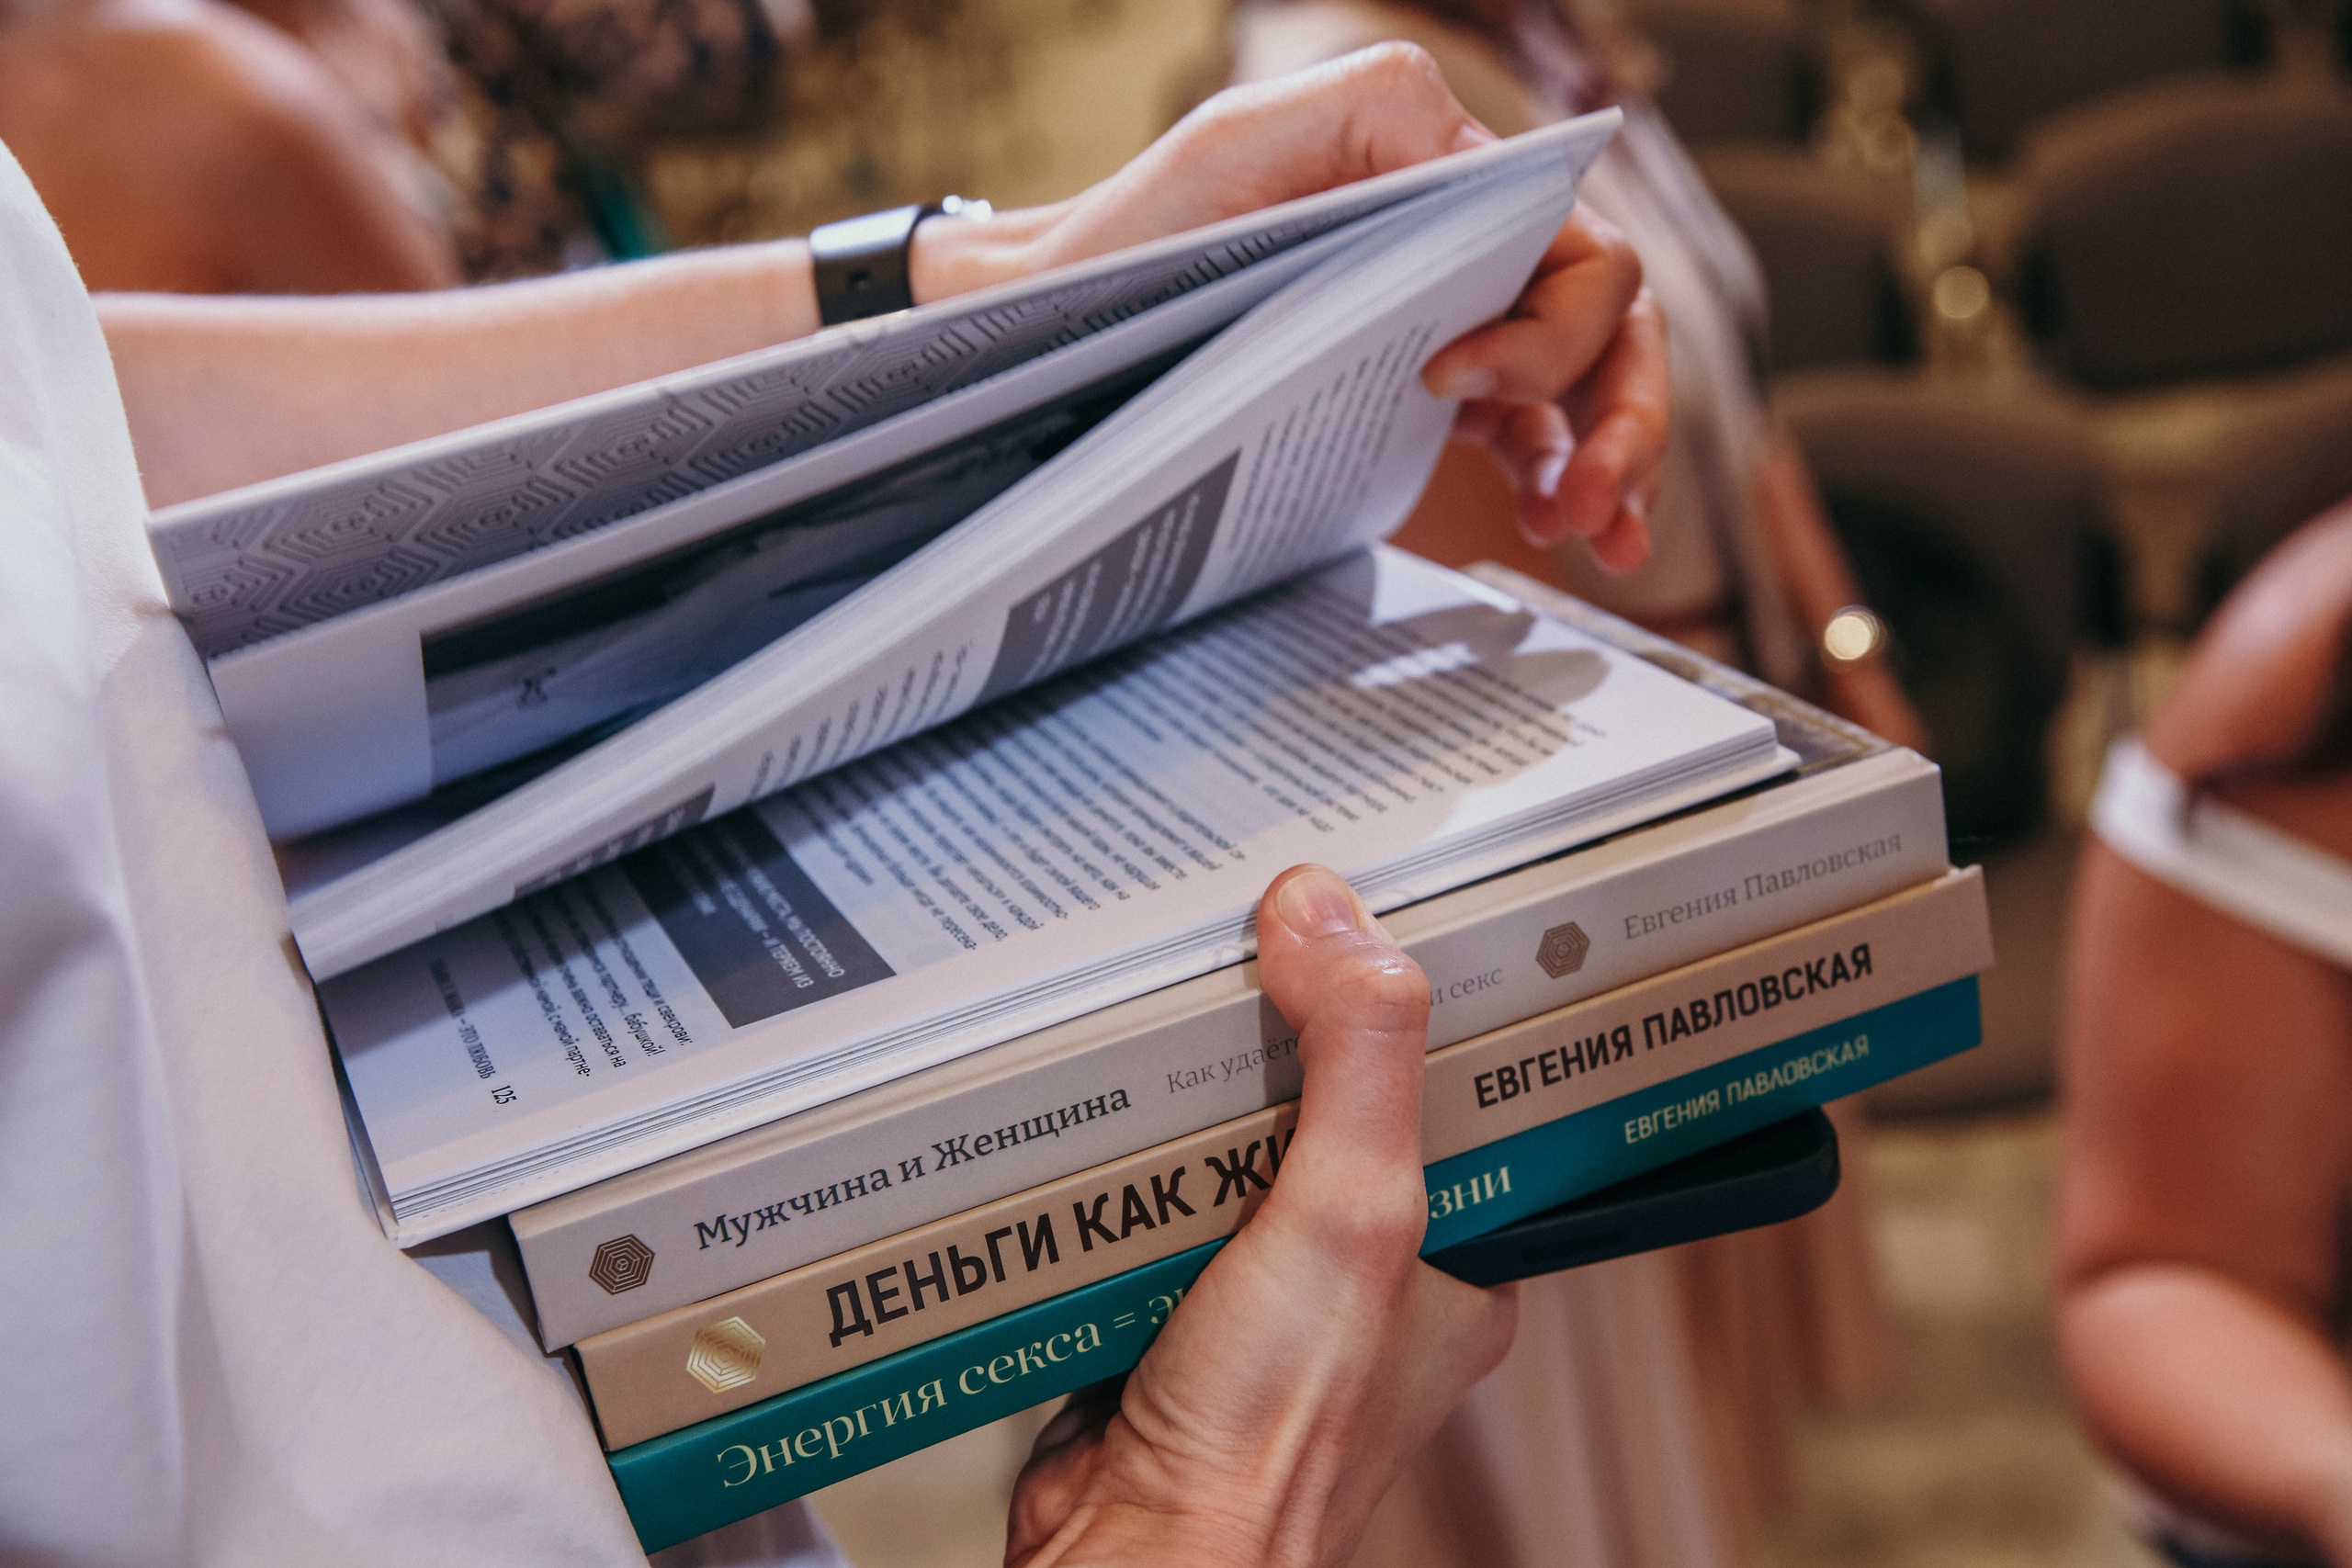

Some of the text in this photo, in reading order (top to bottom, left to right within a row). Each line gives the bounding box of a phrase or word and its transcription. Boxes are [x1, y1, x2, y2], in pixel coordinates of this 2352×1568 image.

[1623, 832, 1904, 942] Евгения Павловская
[467, 1042, 497, 1080] ЛЮБОВЬ
[564, 1042, 592, 1077] партне-
[584, 1010, 621, 1057] оставаться
[610, 1056, 627, 1068] на
[624, 1010, 666, 1057] бабушкой!
[657, 1003, 694, 1046] свекрови:
[1167, 1064, 1216, 1094] Как
[1221, 1033, 1300, 1082] удаёт
[1450, 968, 1503, 999] секс
[1473, 942, 1875, 1111] ЕВГЕНИЯ ПАВЛОВСКАЯ
[491, 1085, 518, 1105] 125
[1623, 1033, 1871, 1146] ЕВГЕНИЯ ПАВЛОВСКАЯ
[693, 1084, 1132, 1250] Мужчина и Женщина
[825, 1210, 1061, 1349] ДЕНЬГИ
[1071, 1165, 1197, 1252] КАК
[716, 1378, 948, 1489] Энергия
[957, 1319, 1103, 1402] секса
[1429, 1165, 1513, 1219] зни
